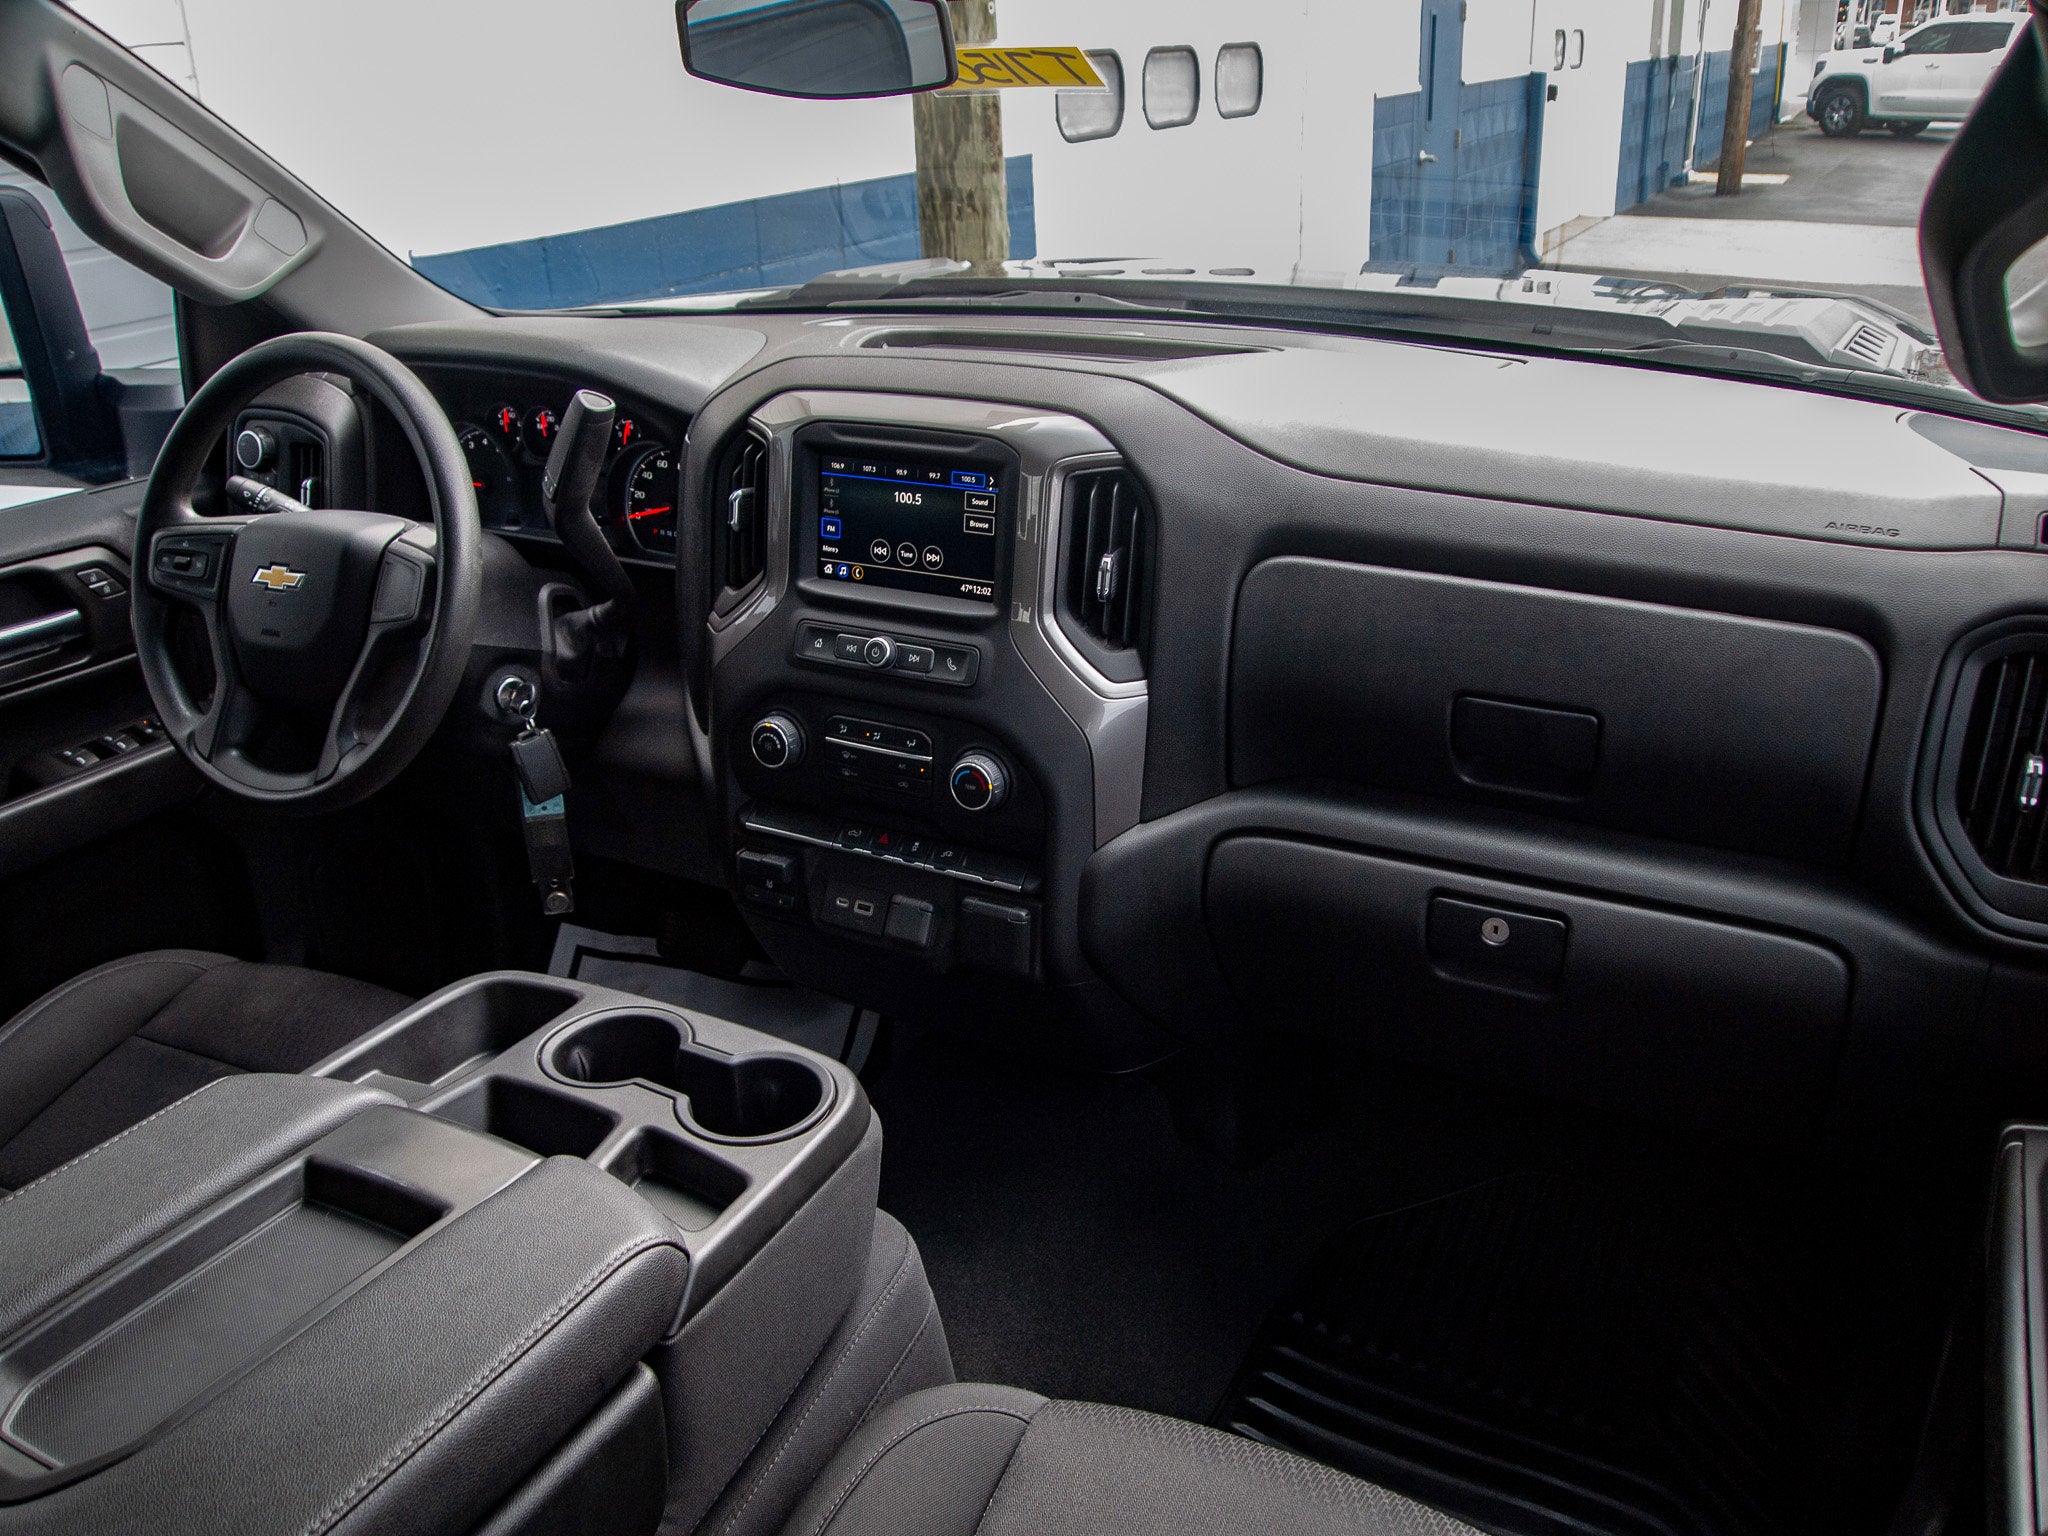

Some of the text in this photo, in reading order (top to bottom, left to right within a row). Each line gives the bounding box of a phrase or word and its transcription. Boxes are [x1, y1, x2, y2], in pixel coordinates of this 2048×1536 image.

[468, 440, 475, 449] 3
[481, 438, 488, 446] 4
[657, 459, 668, 469] 60
[641, 471, 653, 480] 40
[961, 475, 976, 484] 100.5
[634, 490, 645, 499] 20
[893, 491, 922, 505] 100.5
[971, 498, 989, 506] Sound
[826, 525, 836, 533] FM
[969, 520, 989, 529] Browse
[1825, 521, 1900, 538] AIRBAG
[900, 550, 913, 559] Tune
[973, 585, 992, 596] 12:02
